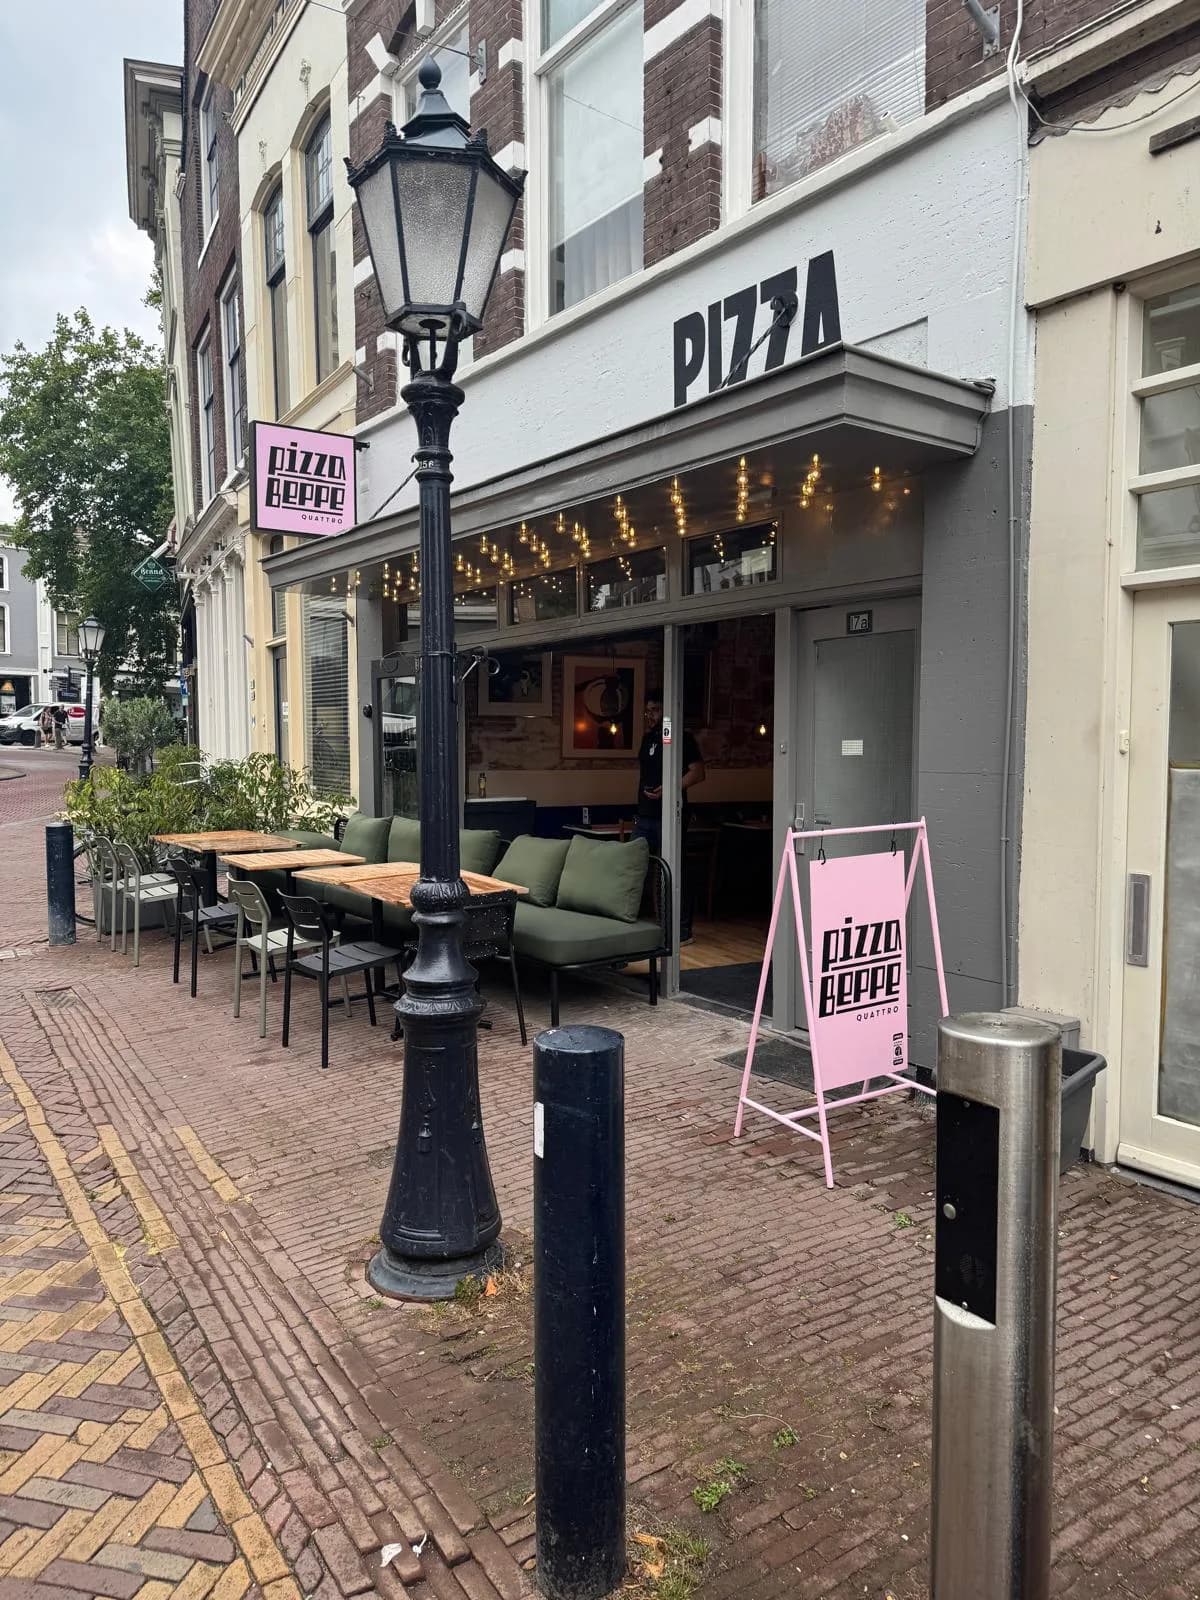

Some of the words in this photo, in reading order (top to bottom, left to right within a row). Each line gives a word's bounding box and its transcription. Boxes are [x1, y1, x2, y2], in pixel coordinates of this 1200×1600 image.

[674, 250, 841, 408] PIZZA
[301, 514, 343, 524] QUATTRO
[856, 1006, 899, 1022] QUATTRO
